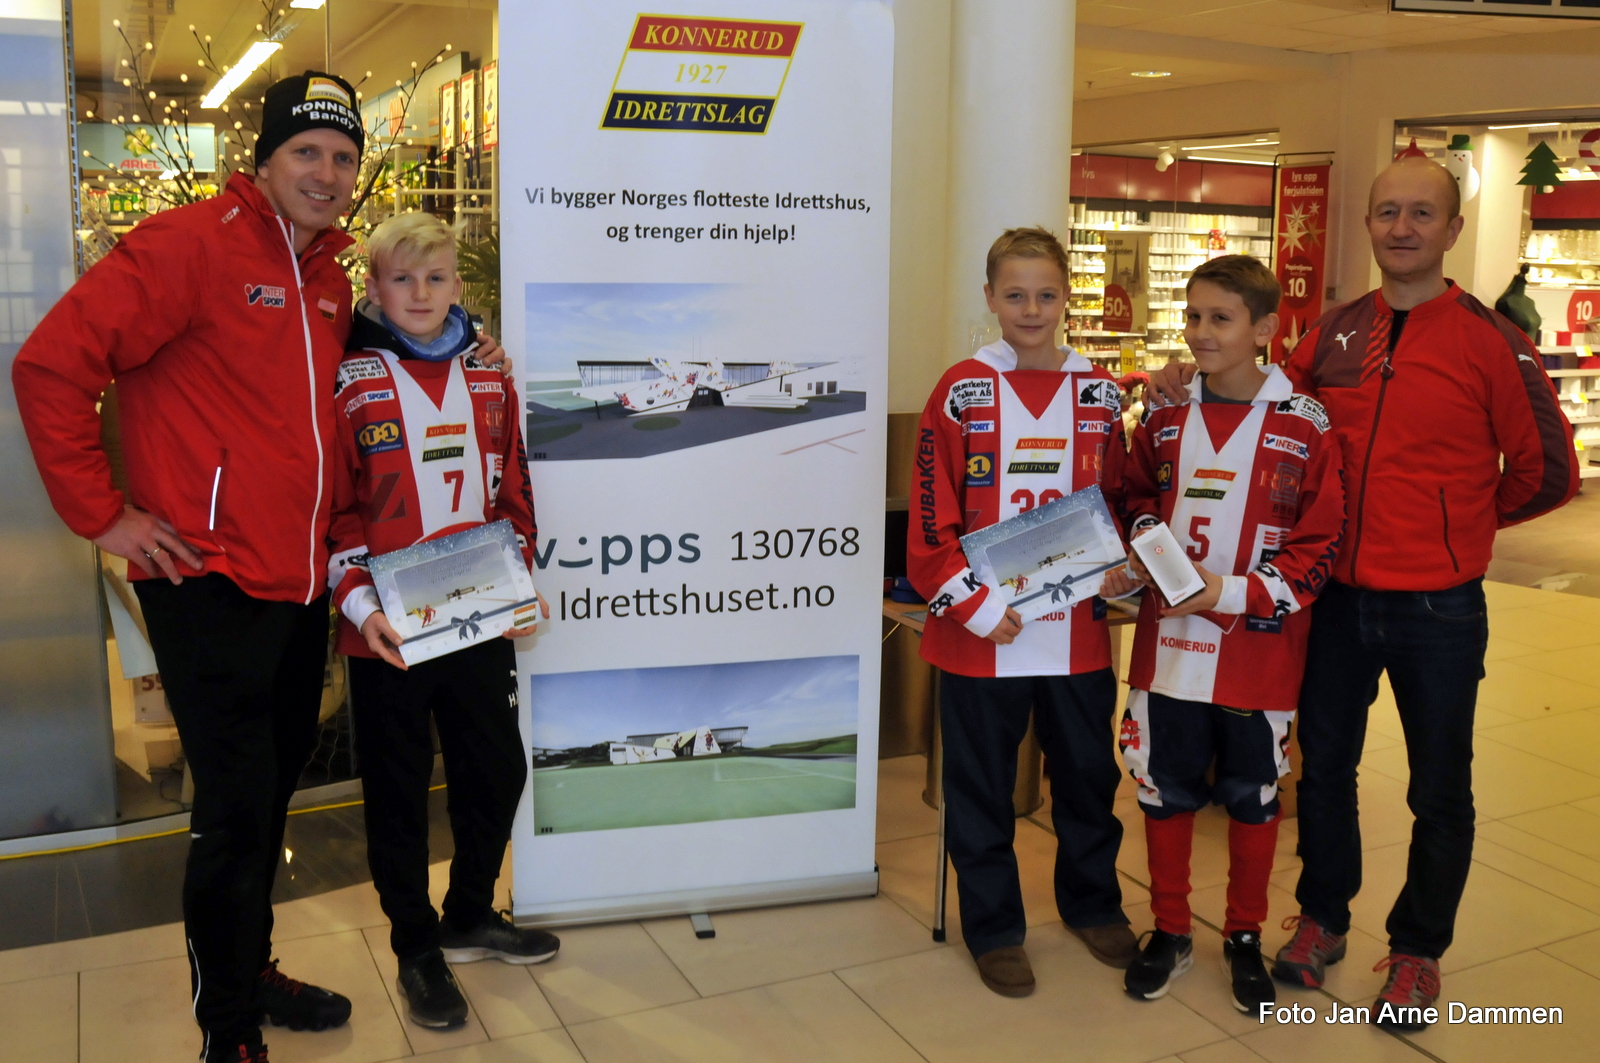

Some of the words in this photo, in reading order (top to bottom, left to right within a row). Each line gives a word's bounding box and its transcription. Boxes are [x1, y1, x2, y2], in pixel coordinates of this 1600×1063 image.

[644, 25, 784, 50] KONNERUD
[674, 63, 728, 84] 1927
[292, 101, 363, 134] KONNERU
[309, 110, 355, 130] Bandy
[613, 100, 766, 125] IDRETTSLAG
[119, 158, 161, 170] ARIEL
[1291, 171, 1303, 182] lys
[1303, 173, 1318, 181] opp
[525, 188, 545, 205] Vi
[551, 187, 617, 209] bygger
[622, 189, 688, 210] Norges
[693, 190, 770, 208] flotteste
[775, 193, 872, 213] Idrettshus,
[606, 225, 630, 242] og
[634, 223, 705, 243] trenger
[709, 223, 739, 240] din
[744, 224, 797, 244] hjelp!
[262, 286, 285, 298] INTER
[263, 297, 285, 308] SPORT
[953, 380, 992, 394] Stærkeby
[1010, 464, 1058, 472] IDRETTSLAG
[443, 470, 464, 513] 7
[919, 428, 940, 545] BRUBAKKEN
[731, 527, 860, 561] 130768
[1186, 516, 1211, 562] 5
[560, 583, 836, 621] Idrettshuset.no
[1161, 636, 1217, 654] KONNERUD
